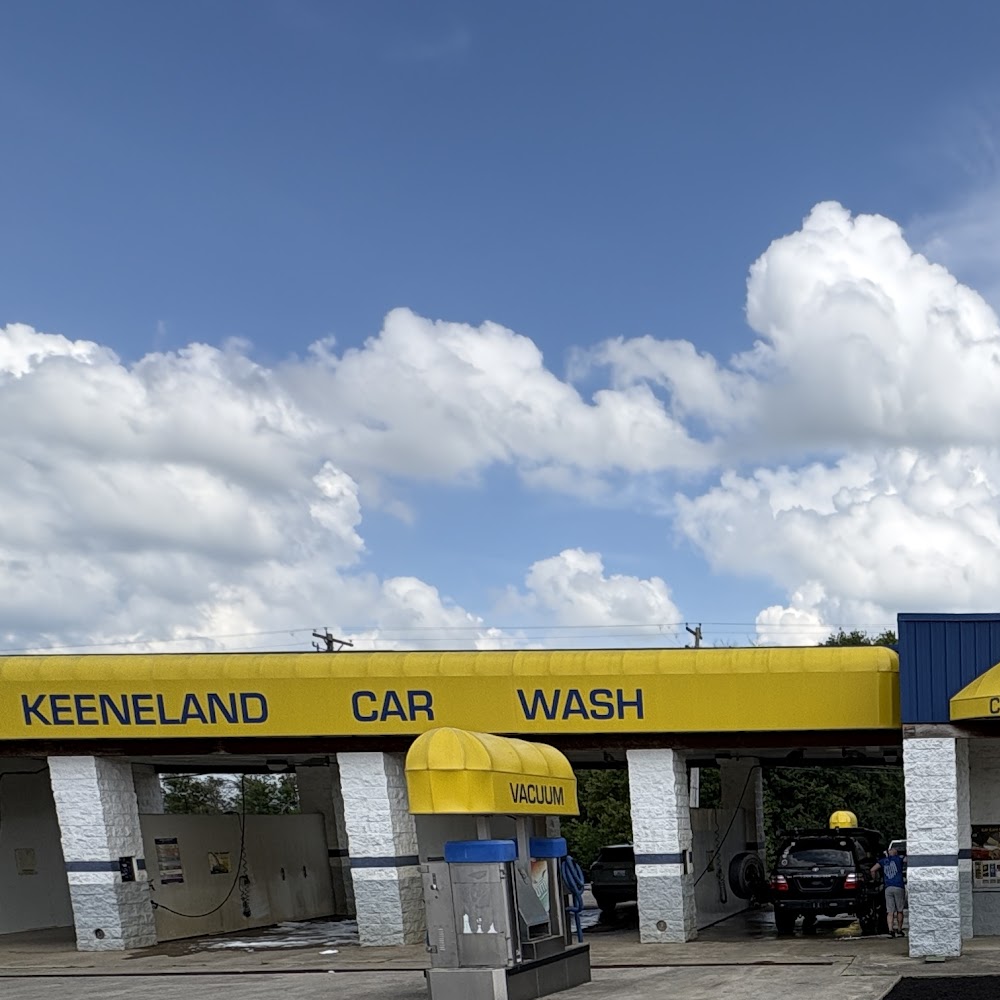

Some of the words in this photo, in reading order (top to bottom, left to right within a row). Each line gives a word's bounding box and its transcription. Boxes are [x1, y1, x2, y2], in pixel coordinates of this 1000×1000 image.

[21, 692, 268, 726] KEENELAND
[352, 690, 435, 722] CAR
[517, 688, 644, 721] WASH
[509, 782, 565, 806] VACUUM
